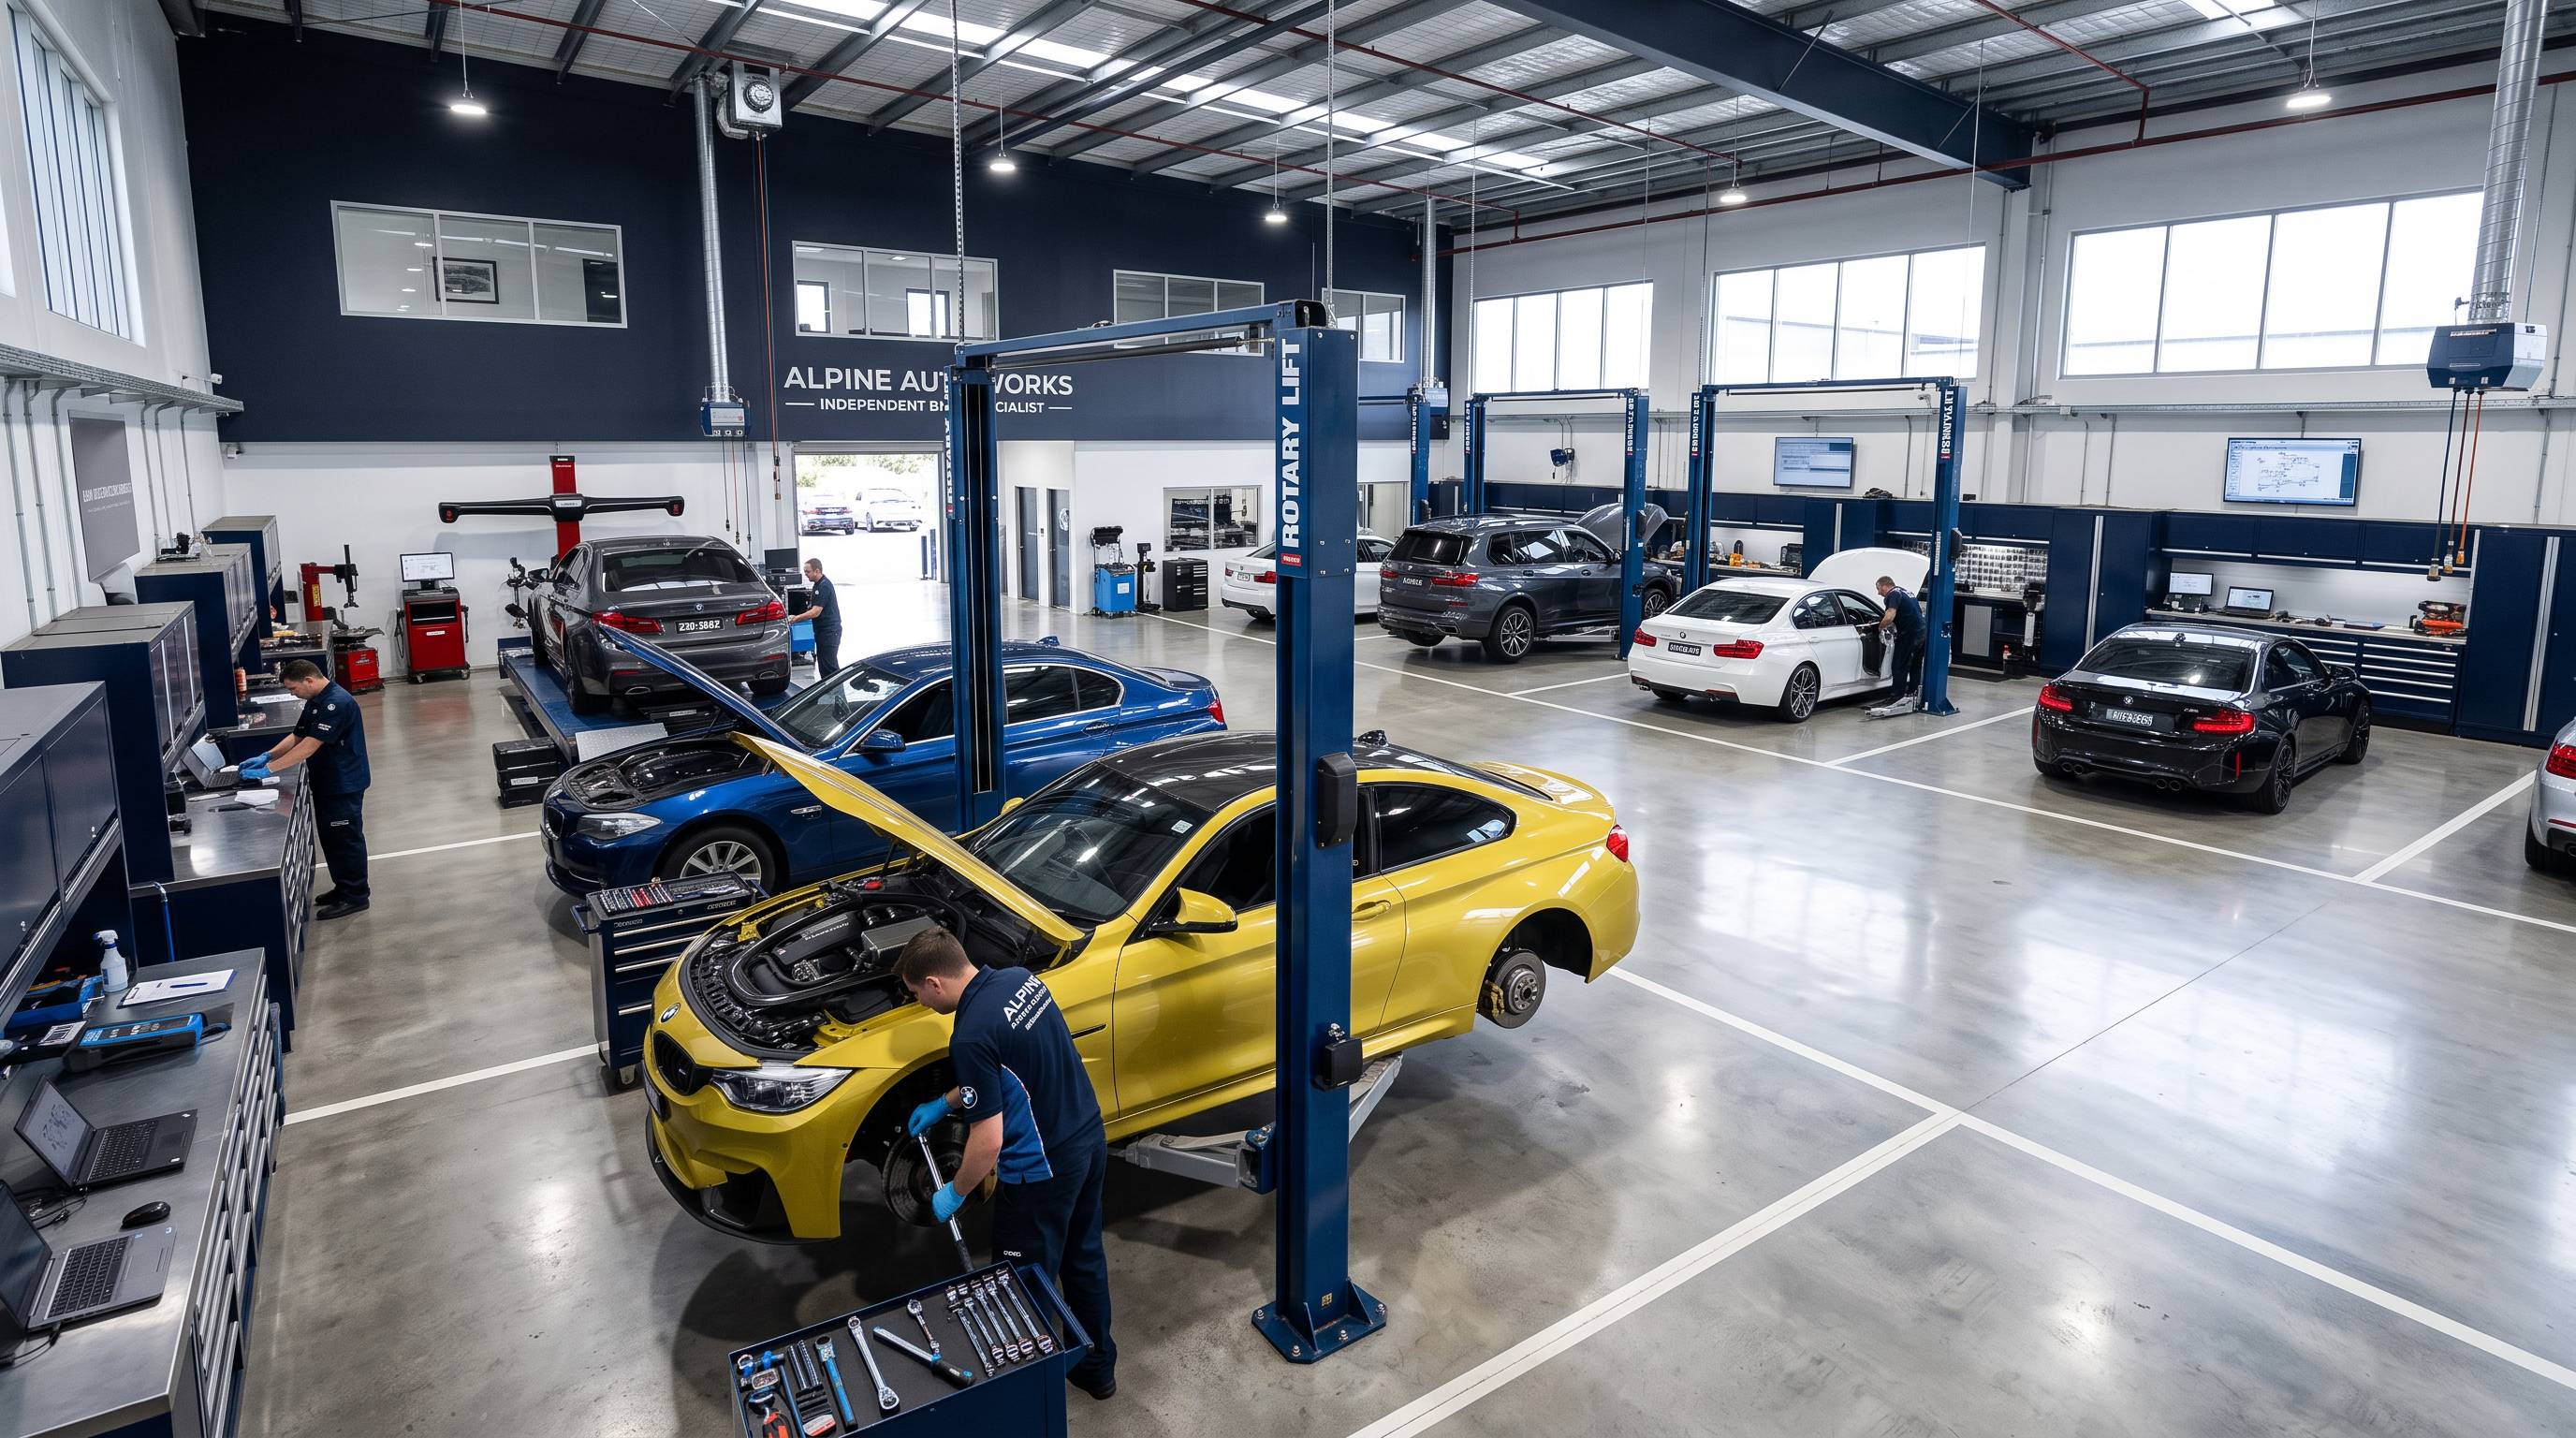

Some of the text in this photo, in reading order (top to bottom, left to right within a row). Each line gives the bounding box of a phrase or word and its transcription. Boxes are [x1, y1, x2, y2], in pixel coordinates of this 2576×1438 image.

[783, 366, 892, 391] ALPINE
[1281, 338, 1300, 405] LIFT
[820, 398, 926, 412] INDEPENDENT
[1281, 417, 1299, 548] ROTARY
